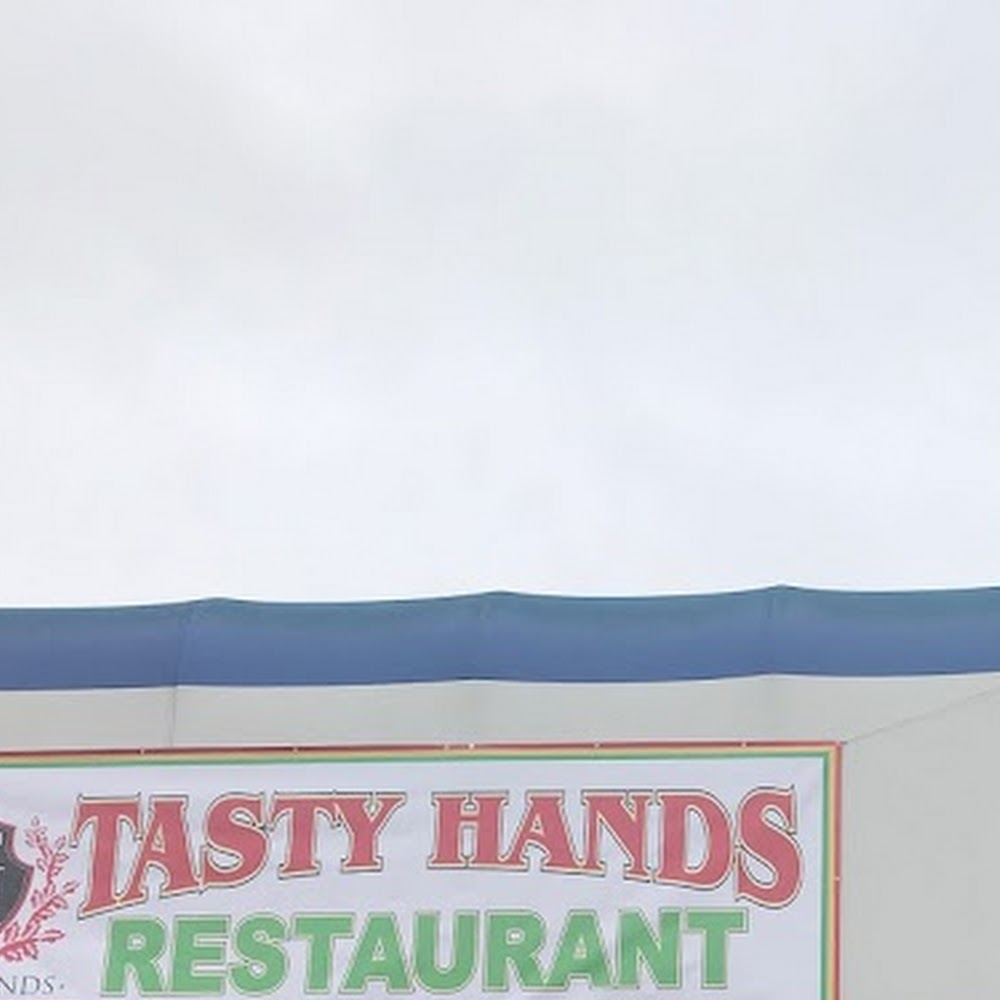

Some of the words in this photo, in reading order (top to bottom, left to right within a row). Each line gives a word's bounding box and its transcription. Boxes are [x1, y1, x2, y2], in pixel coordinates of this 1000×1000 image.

[69, 791, 407, 919] TASTY
[426, 784, 804, 908] HANDS
[100, 908, 748, 997] RESTAURANT
